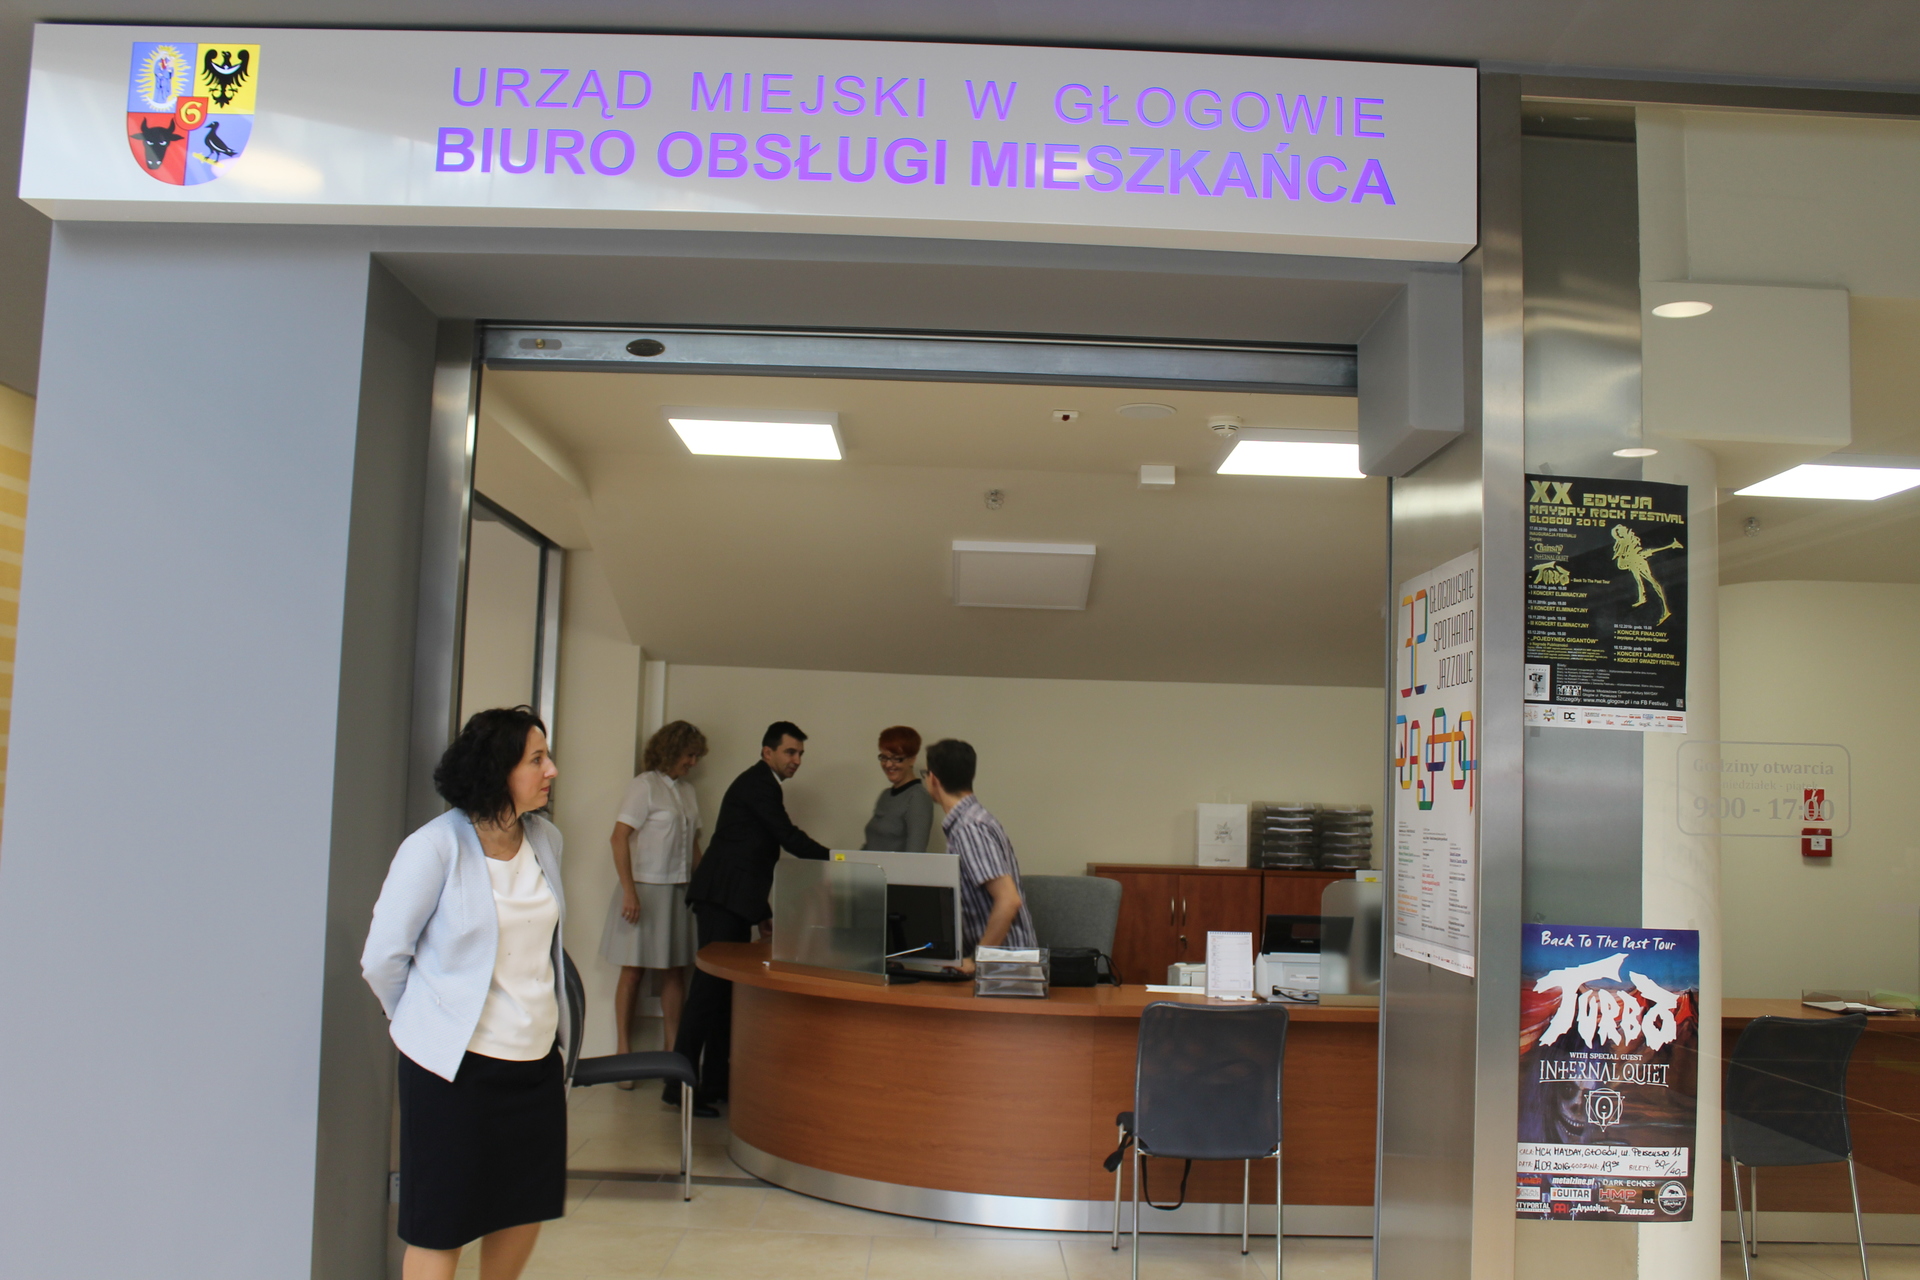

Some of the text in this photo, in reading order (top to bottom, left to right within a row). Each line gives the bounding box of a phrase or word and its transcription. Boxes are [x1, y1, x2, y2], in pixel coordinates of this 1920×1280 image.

[451, 66, 1387, 139] URZĄD MIEJSKI W GŁOGOWIE
[434, 125, 1397, 206] BIURO OBSŁUGI MIESZKAŃCA
[1529, 480, 1653, 510] XX EDYCJA
[1529, 504, 1685, 525] MAYDAY ROCK FESTIVAL
[1575, 518, 1607, 528] 2016
[1436, 650, 1474, 690] JAZZOWE
[1762, 760, 1835, 776] otwarcia
[1692, 795, 1746, 820] 9:00
[1767, 797, 1835, 822] 17:00
[1541, 930, 1676, 951] Back To The Past Tour
[1532, 952, 1680, 1052] TURBO
[1569, 1051, 1643, 1061] WITH SPECIAL GUEST
[1539, 1059, 1670, 1086] INTERNAL QUIET
[1602, 1178, 1624, 1187] DARK
[1626, 1180, 1656, 1188] ECHOES
[1599, 1188, 1637, 1200] HMP
[1618, 1204, 1656, 1216] Ibanez
